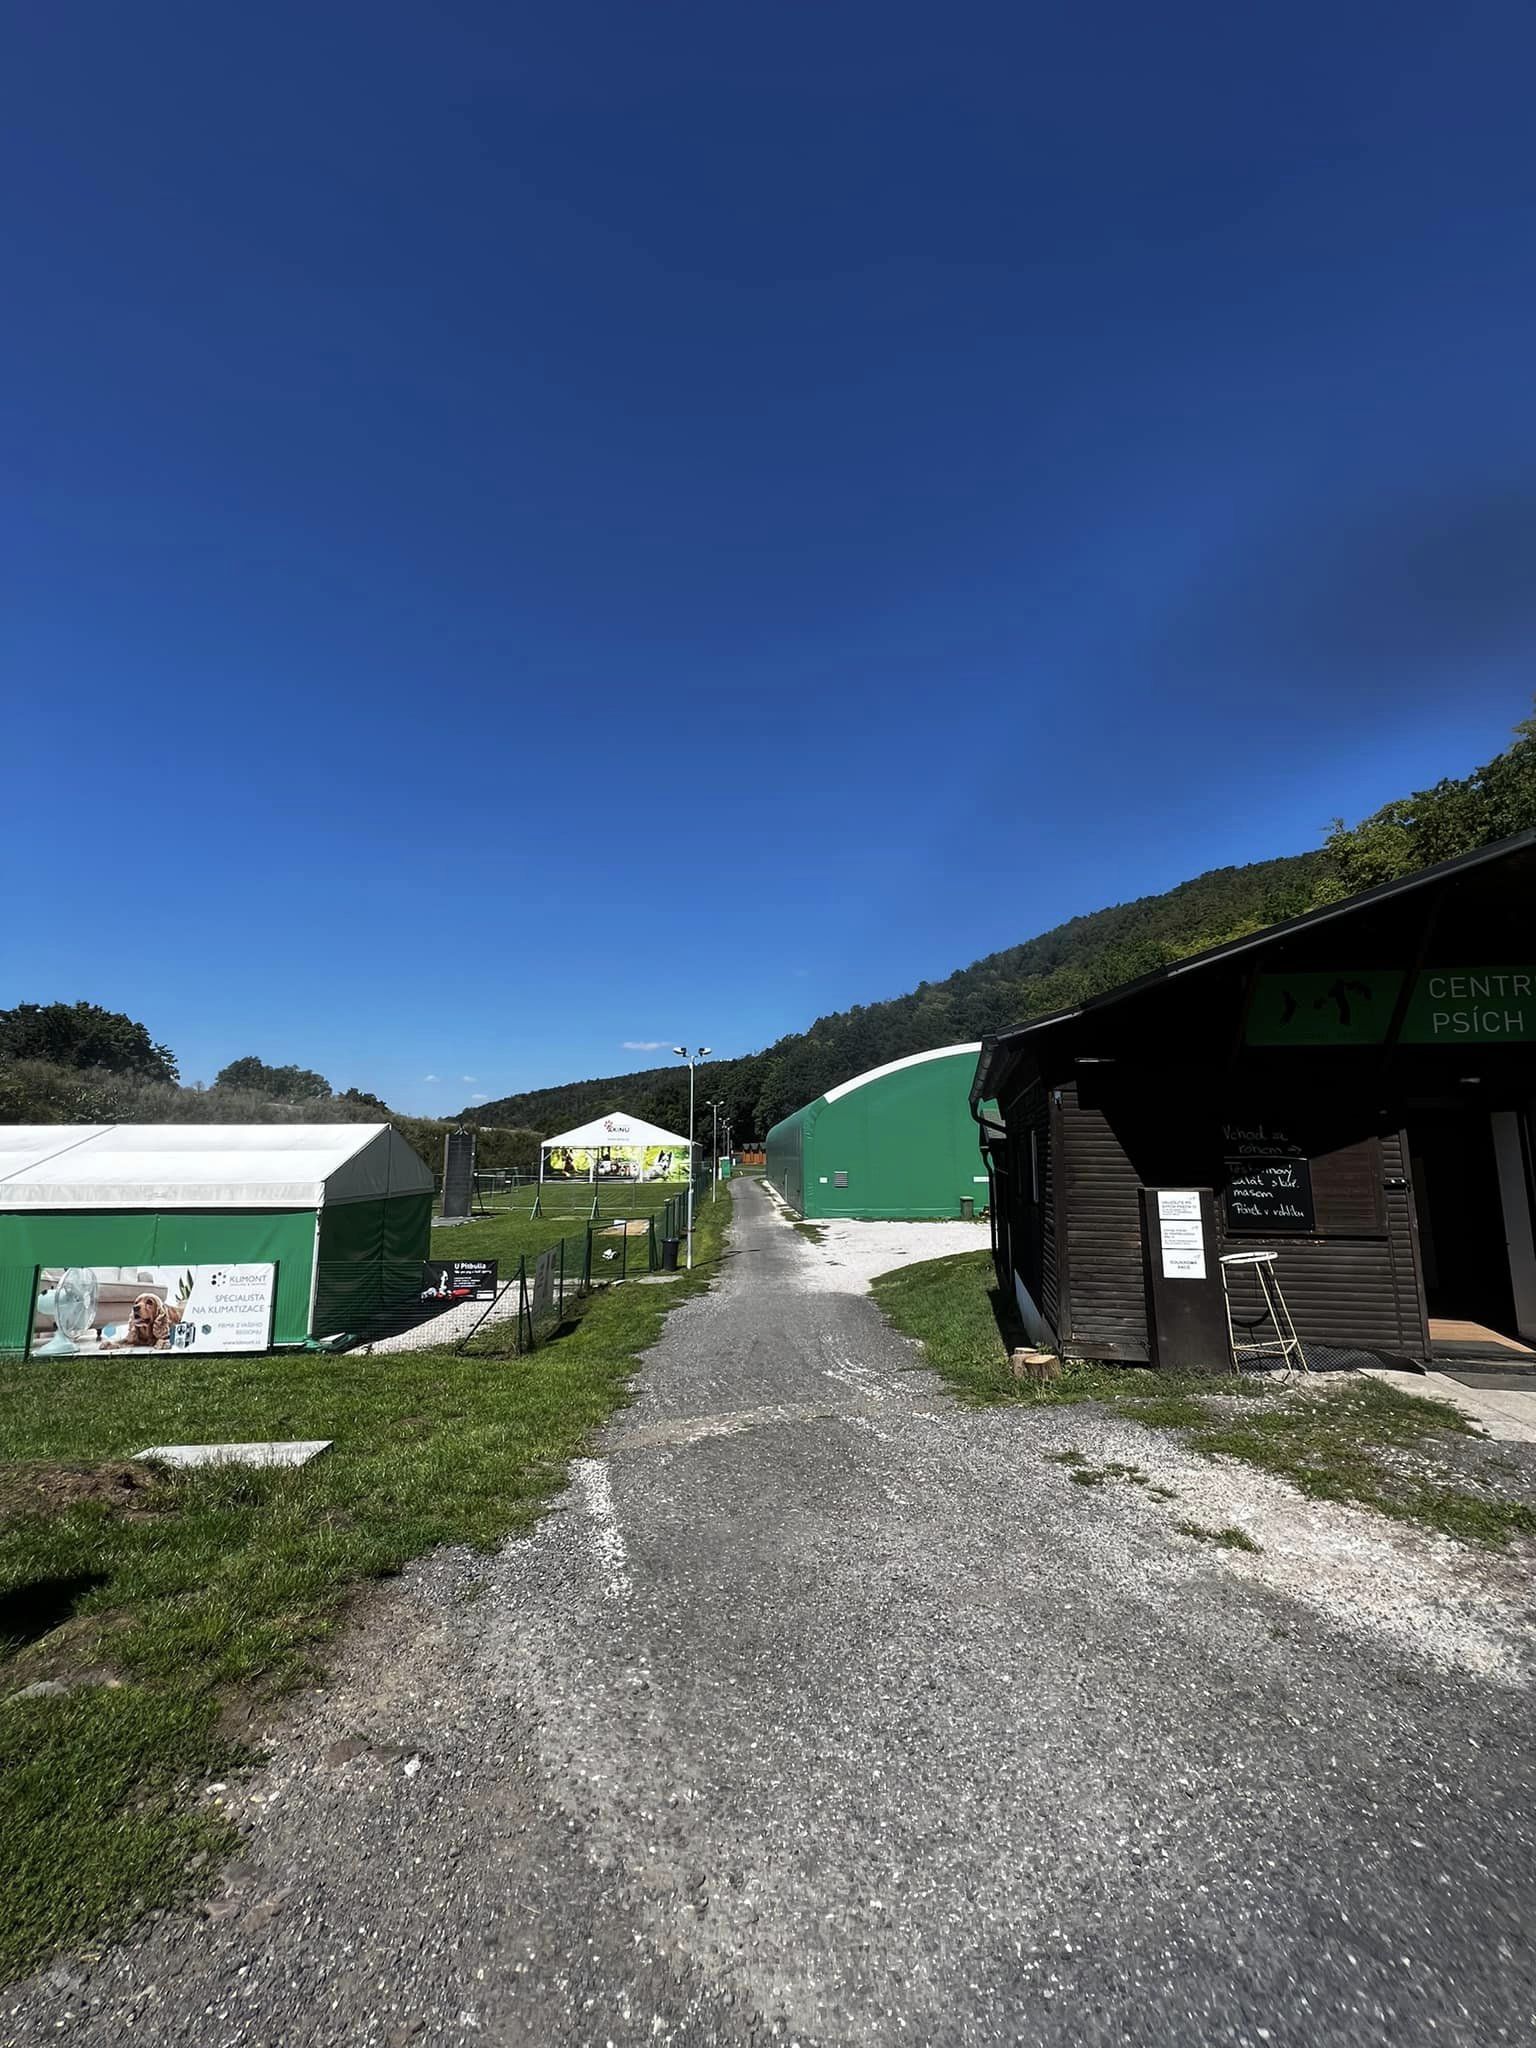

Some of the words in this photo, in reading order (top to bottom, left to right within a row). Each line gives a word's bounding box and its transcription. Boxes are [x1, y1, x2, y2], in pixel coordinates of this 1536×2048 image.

[1428, 974, 1536, 999] CENTR
[1432, 1005, 1524, 1035] PSÍCH
[1233, 1188, 1274, 1198] masem
[230, 1275, 267, 1283] KLIMONT
[215, 1294, 264, 1302] SPECIALISTA
[192, 1306, 206, 1314] NA
[208, 1305, 264, 1313] KLIMATIZACE
